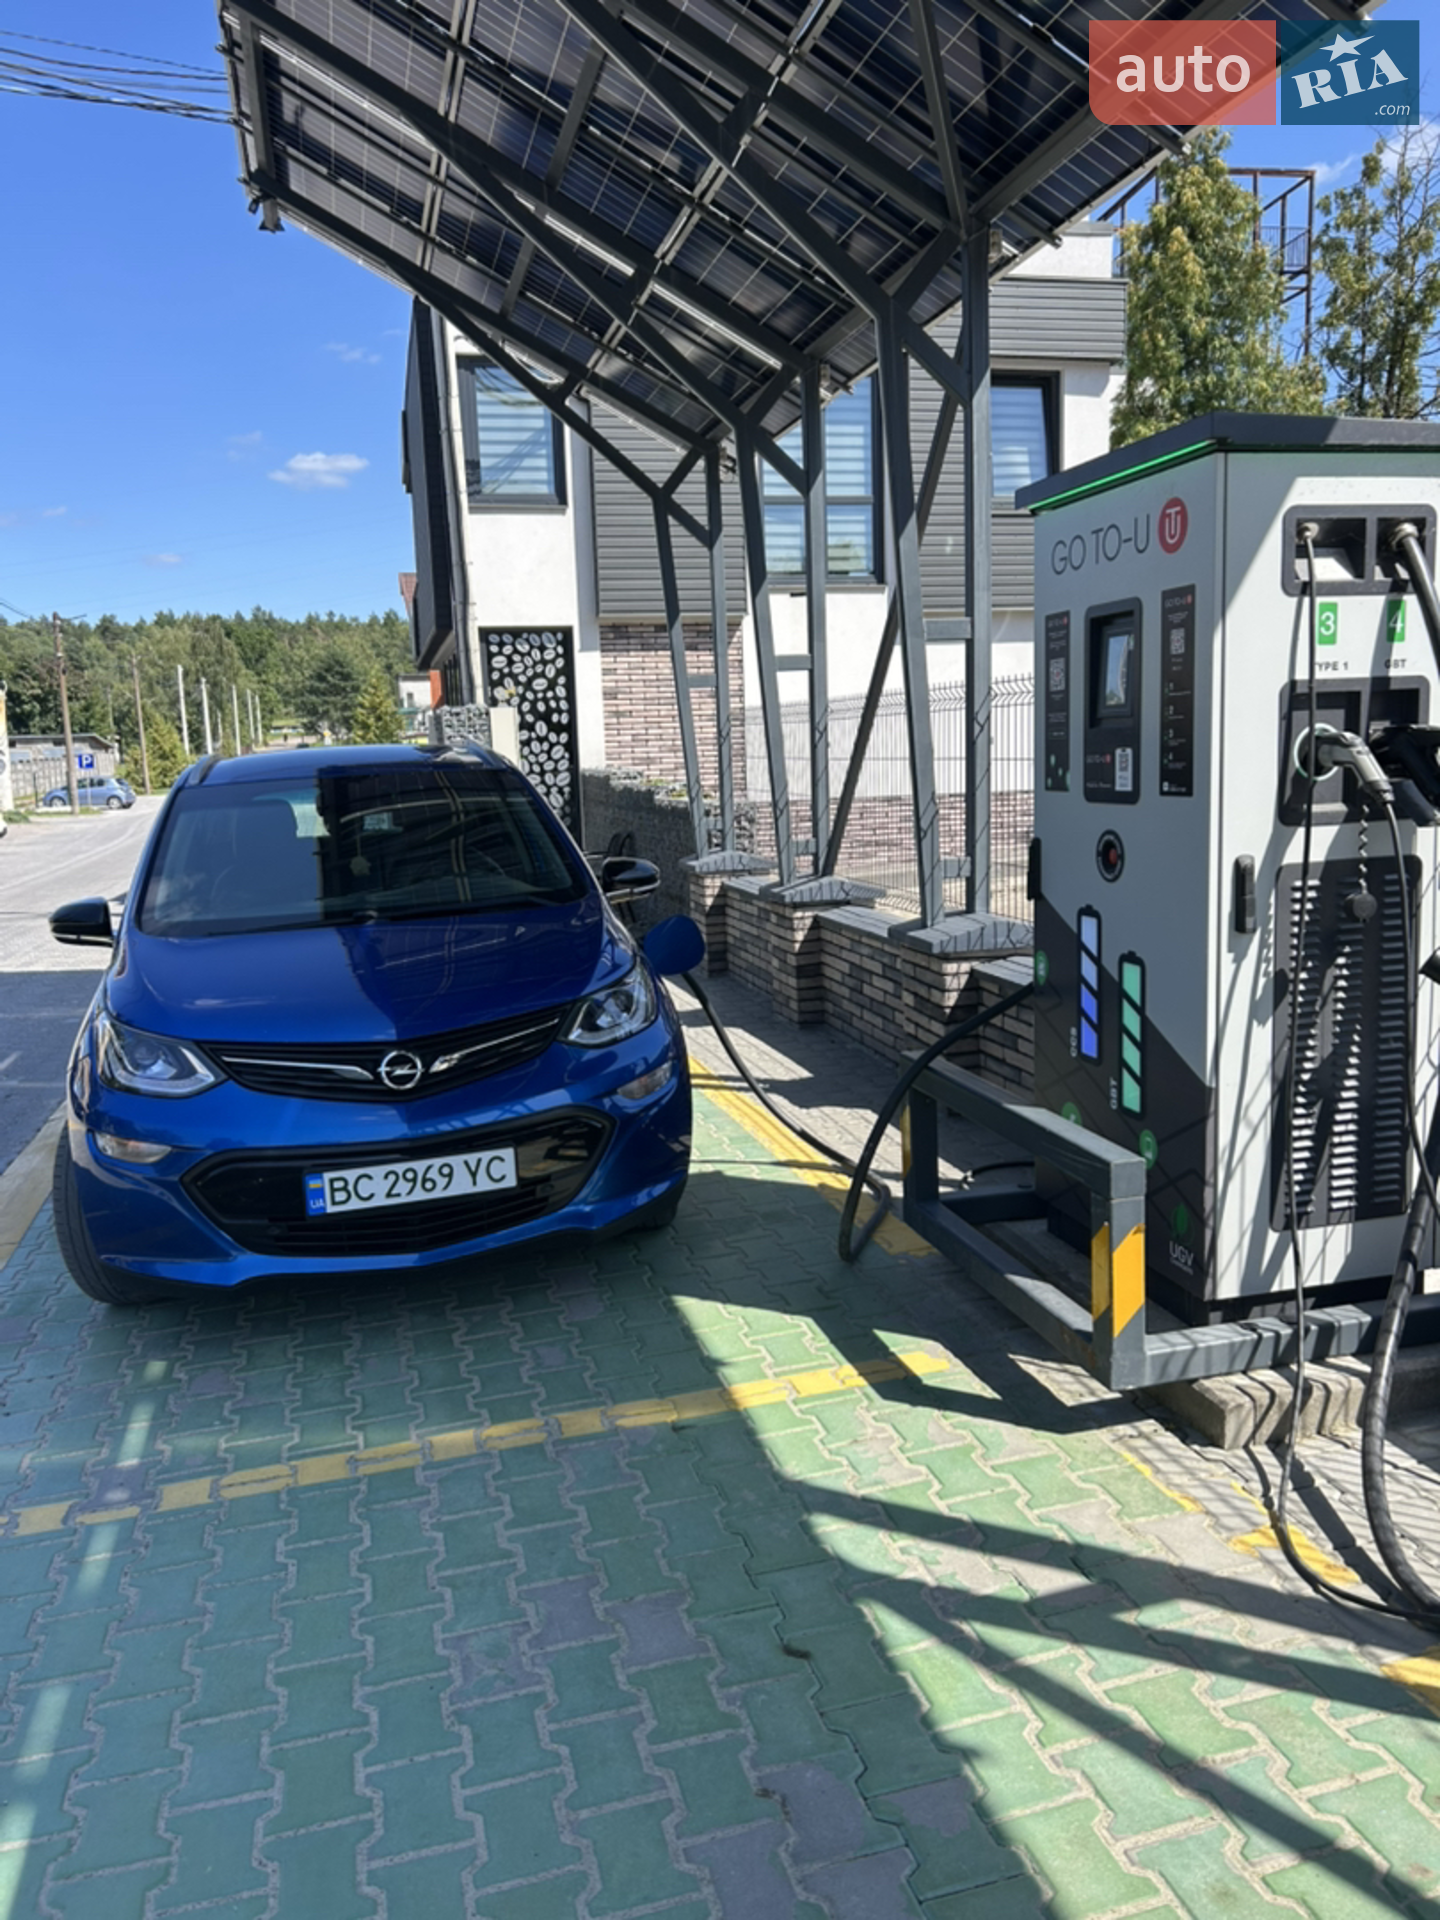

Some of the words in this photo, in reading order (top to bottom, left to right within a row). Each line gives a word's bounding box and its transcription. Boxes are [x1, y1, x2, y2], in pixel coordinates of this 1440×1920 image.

[1051, 534, 1087, 575] GO
[1091, 513, 1150, 565] TO-U
[1320, 611, 1335, 636] 3
[1389, 609, 1404, 634] 4
[1314, 661, 1339, 672] YPE
[1342, 661, 1349, 671] 1
[1384, 658, 1407, 670] GBT
[82, 755, 91, 768] P
[328, 1173, 375, 1206] BC
[383, 1162, 454, 1199] 2969
[463, 1156, 507, 1187] YC
